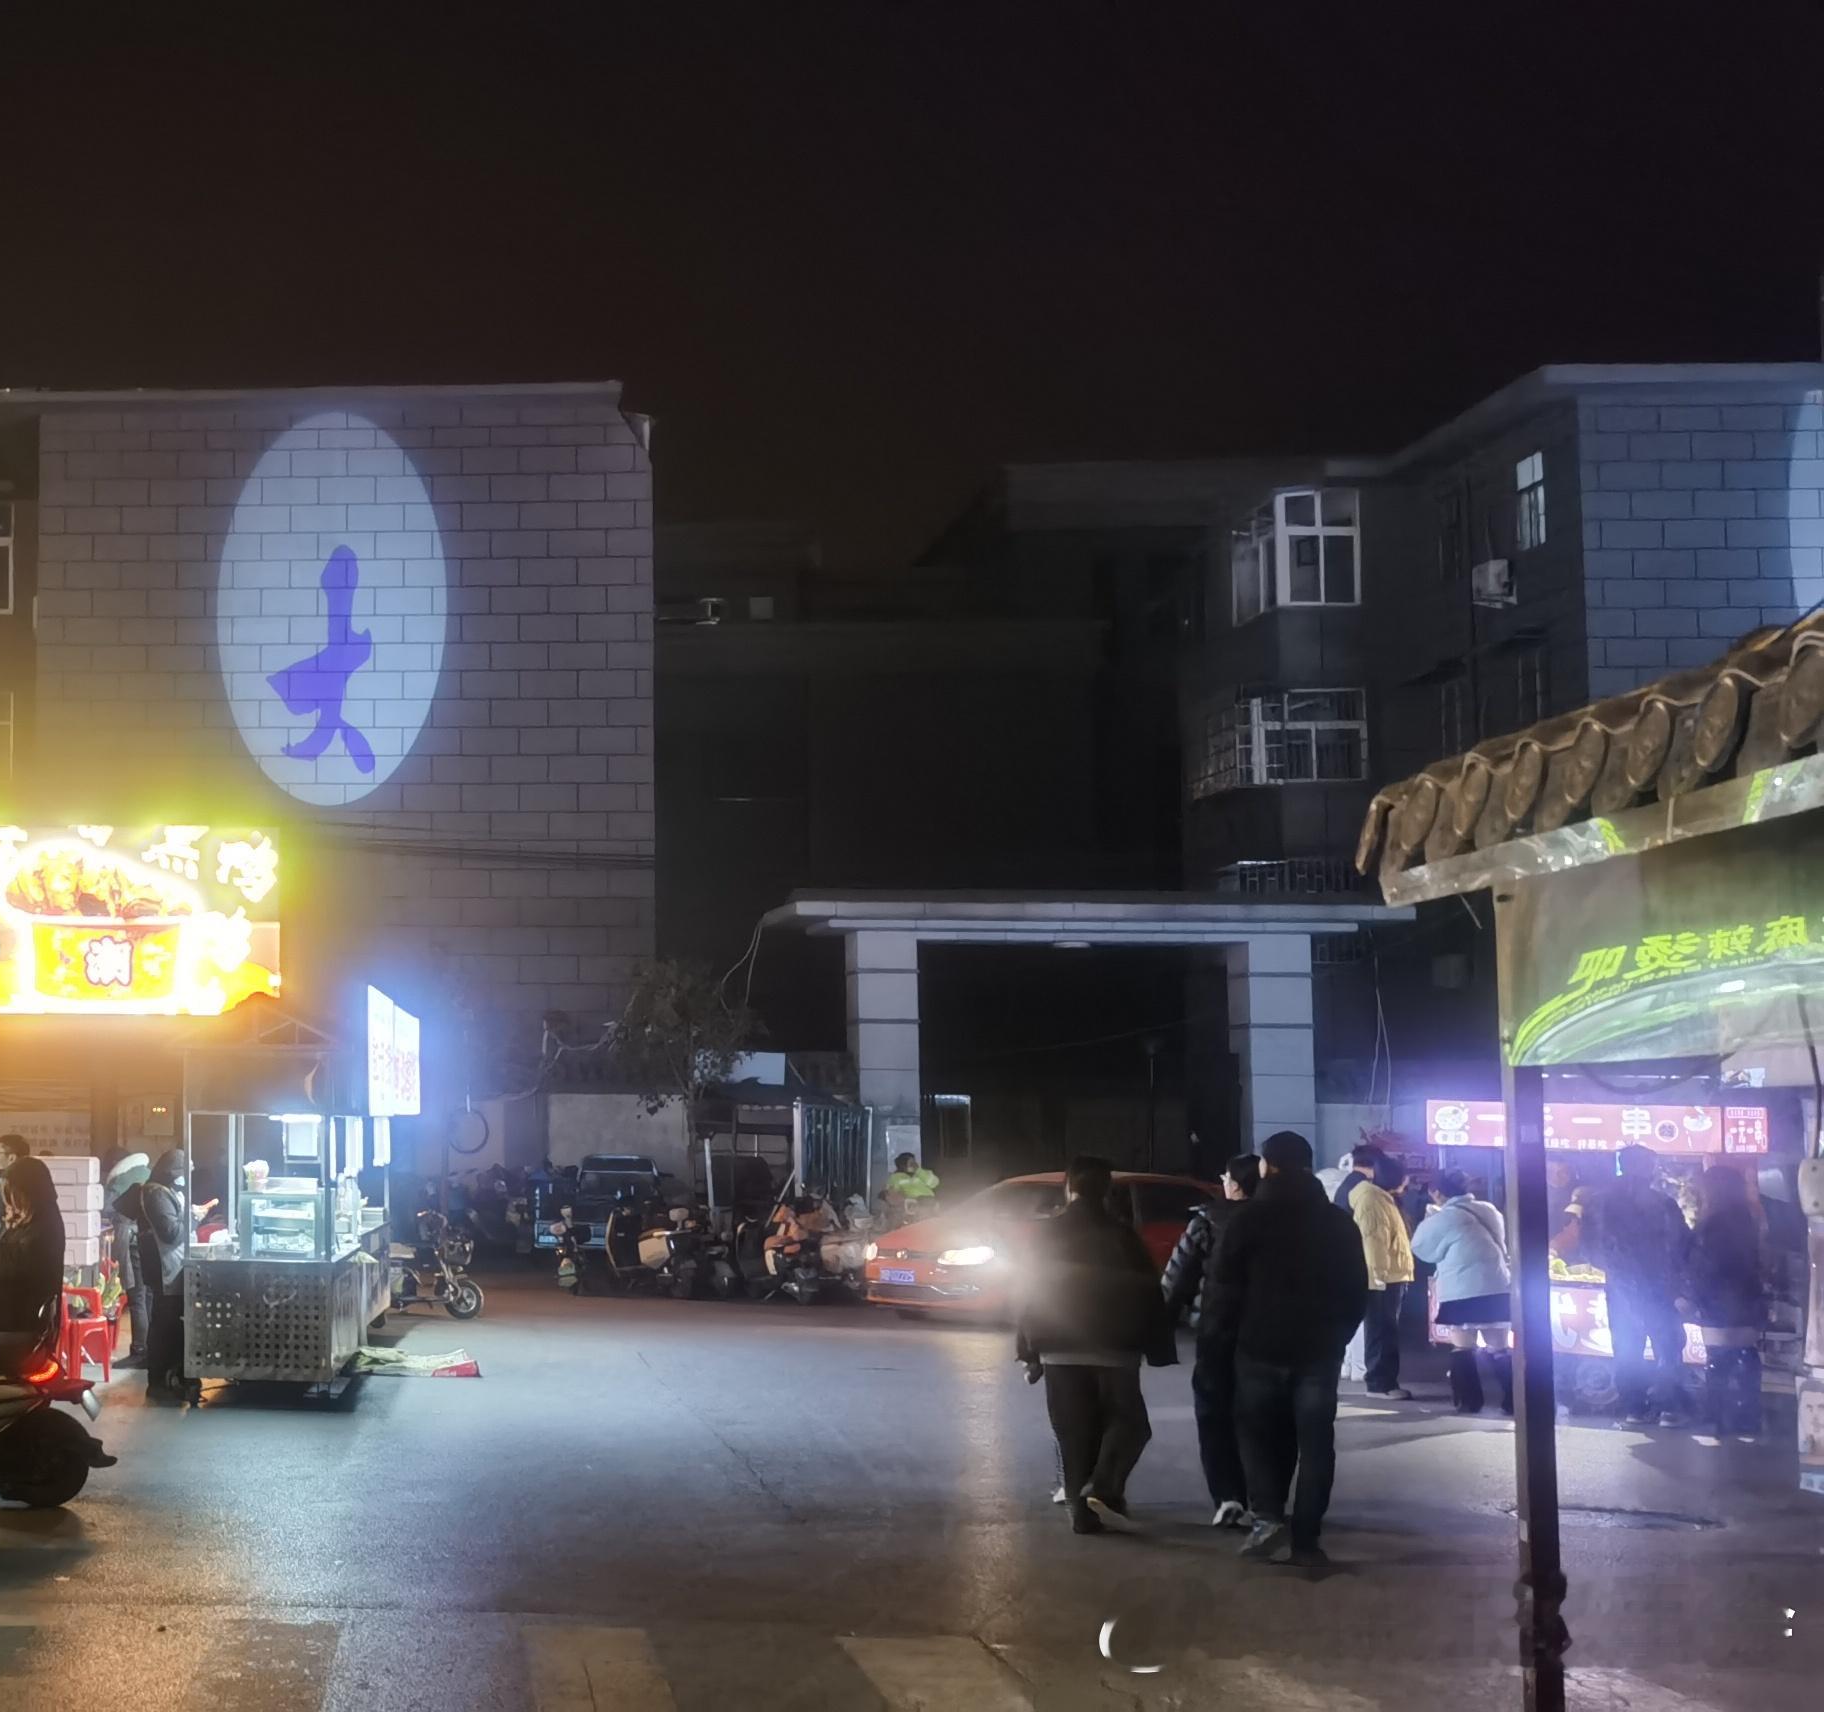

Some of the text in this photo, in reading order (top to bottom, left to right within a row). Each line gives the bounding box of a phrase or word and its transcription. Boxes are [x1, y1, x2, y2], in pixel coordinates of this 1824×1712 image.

[266, 544, 376, 775] 大
[1476, 1106, 1652, 1140] 一一串
